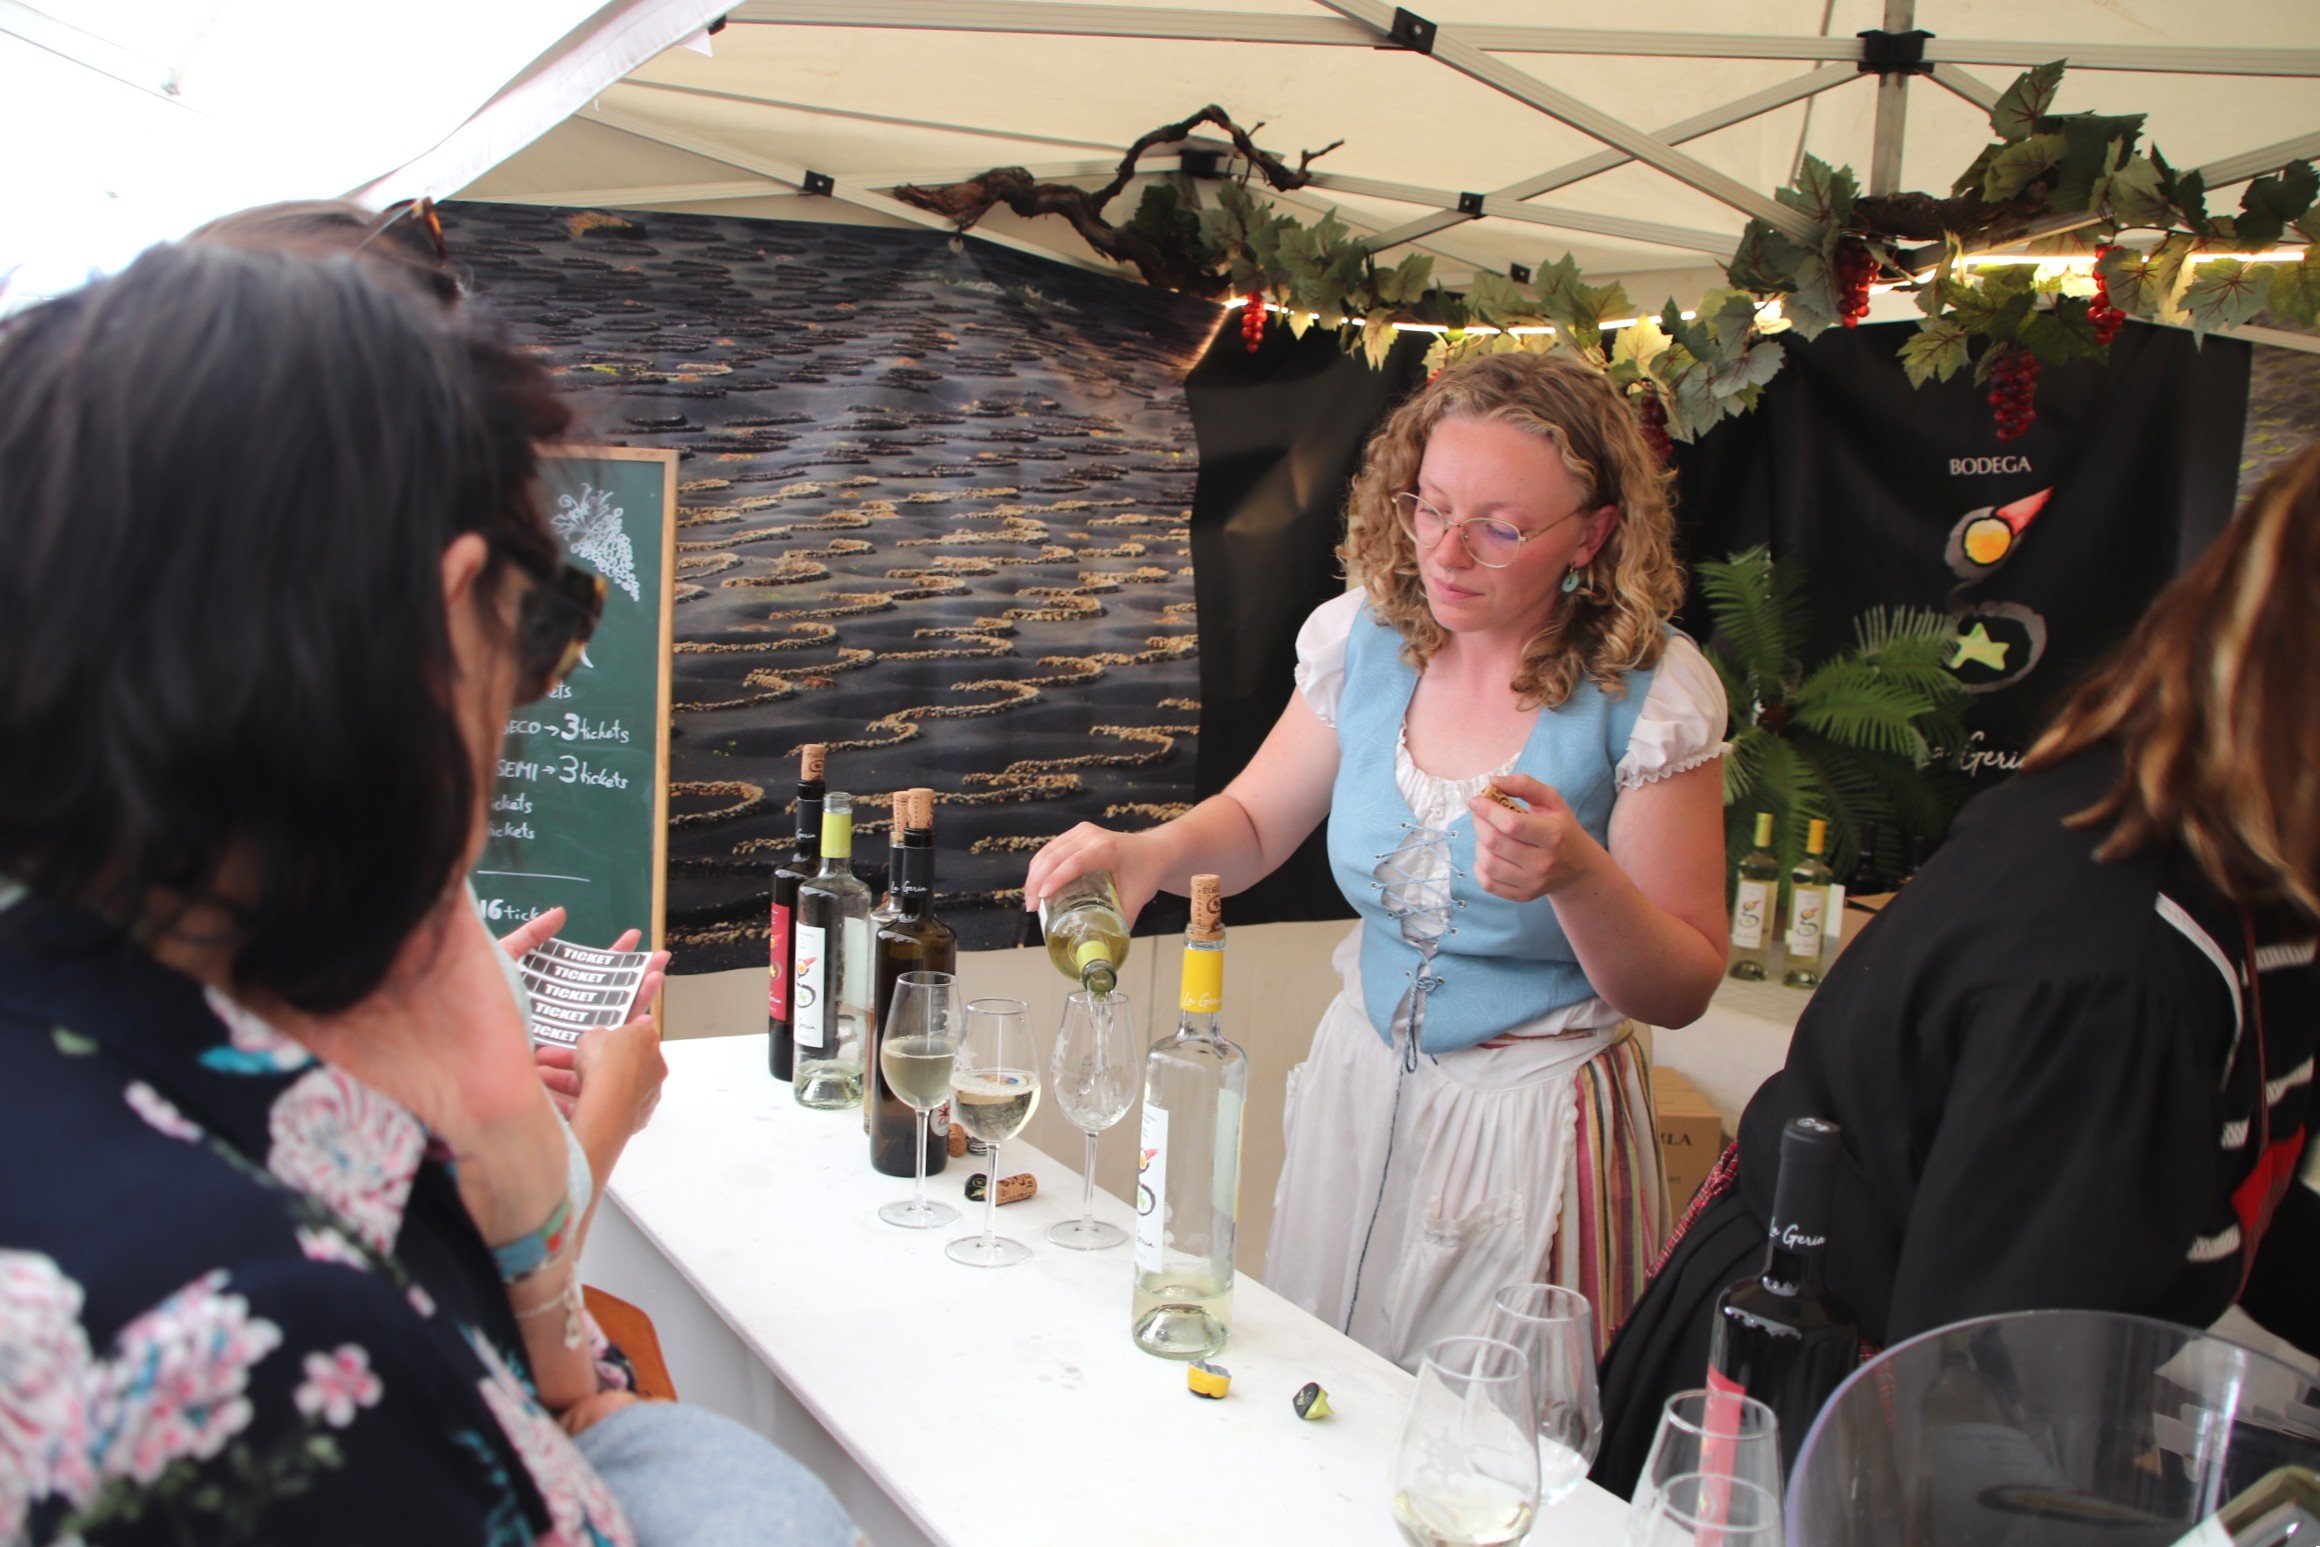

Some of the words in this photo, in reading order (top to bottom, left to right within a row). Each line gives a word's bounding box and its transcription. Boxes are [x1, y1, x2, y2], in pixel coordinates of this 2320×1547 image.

[1949, 455, 2032, 476] BODEGA
[548, 680, 572, 699] ets
[563, 947, 615, 966] TICKET
[554, 965, 607, 983] TICKET
[545, 983, 598, 1002] TICKET
[536, 1002, 589, 1022] TICKET
[1782, 1223, 1826, 1249] Geria
